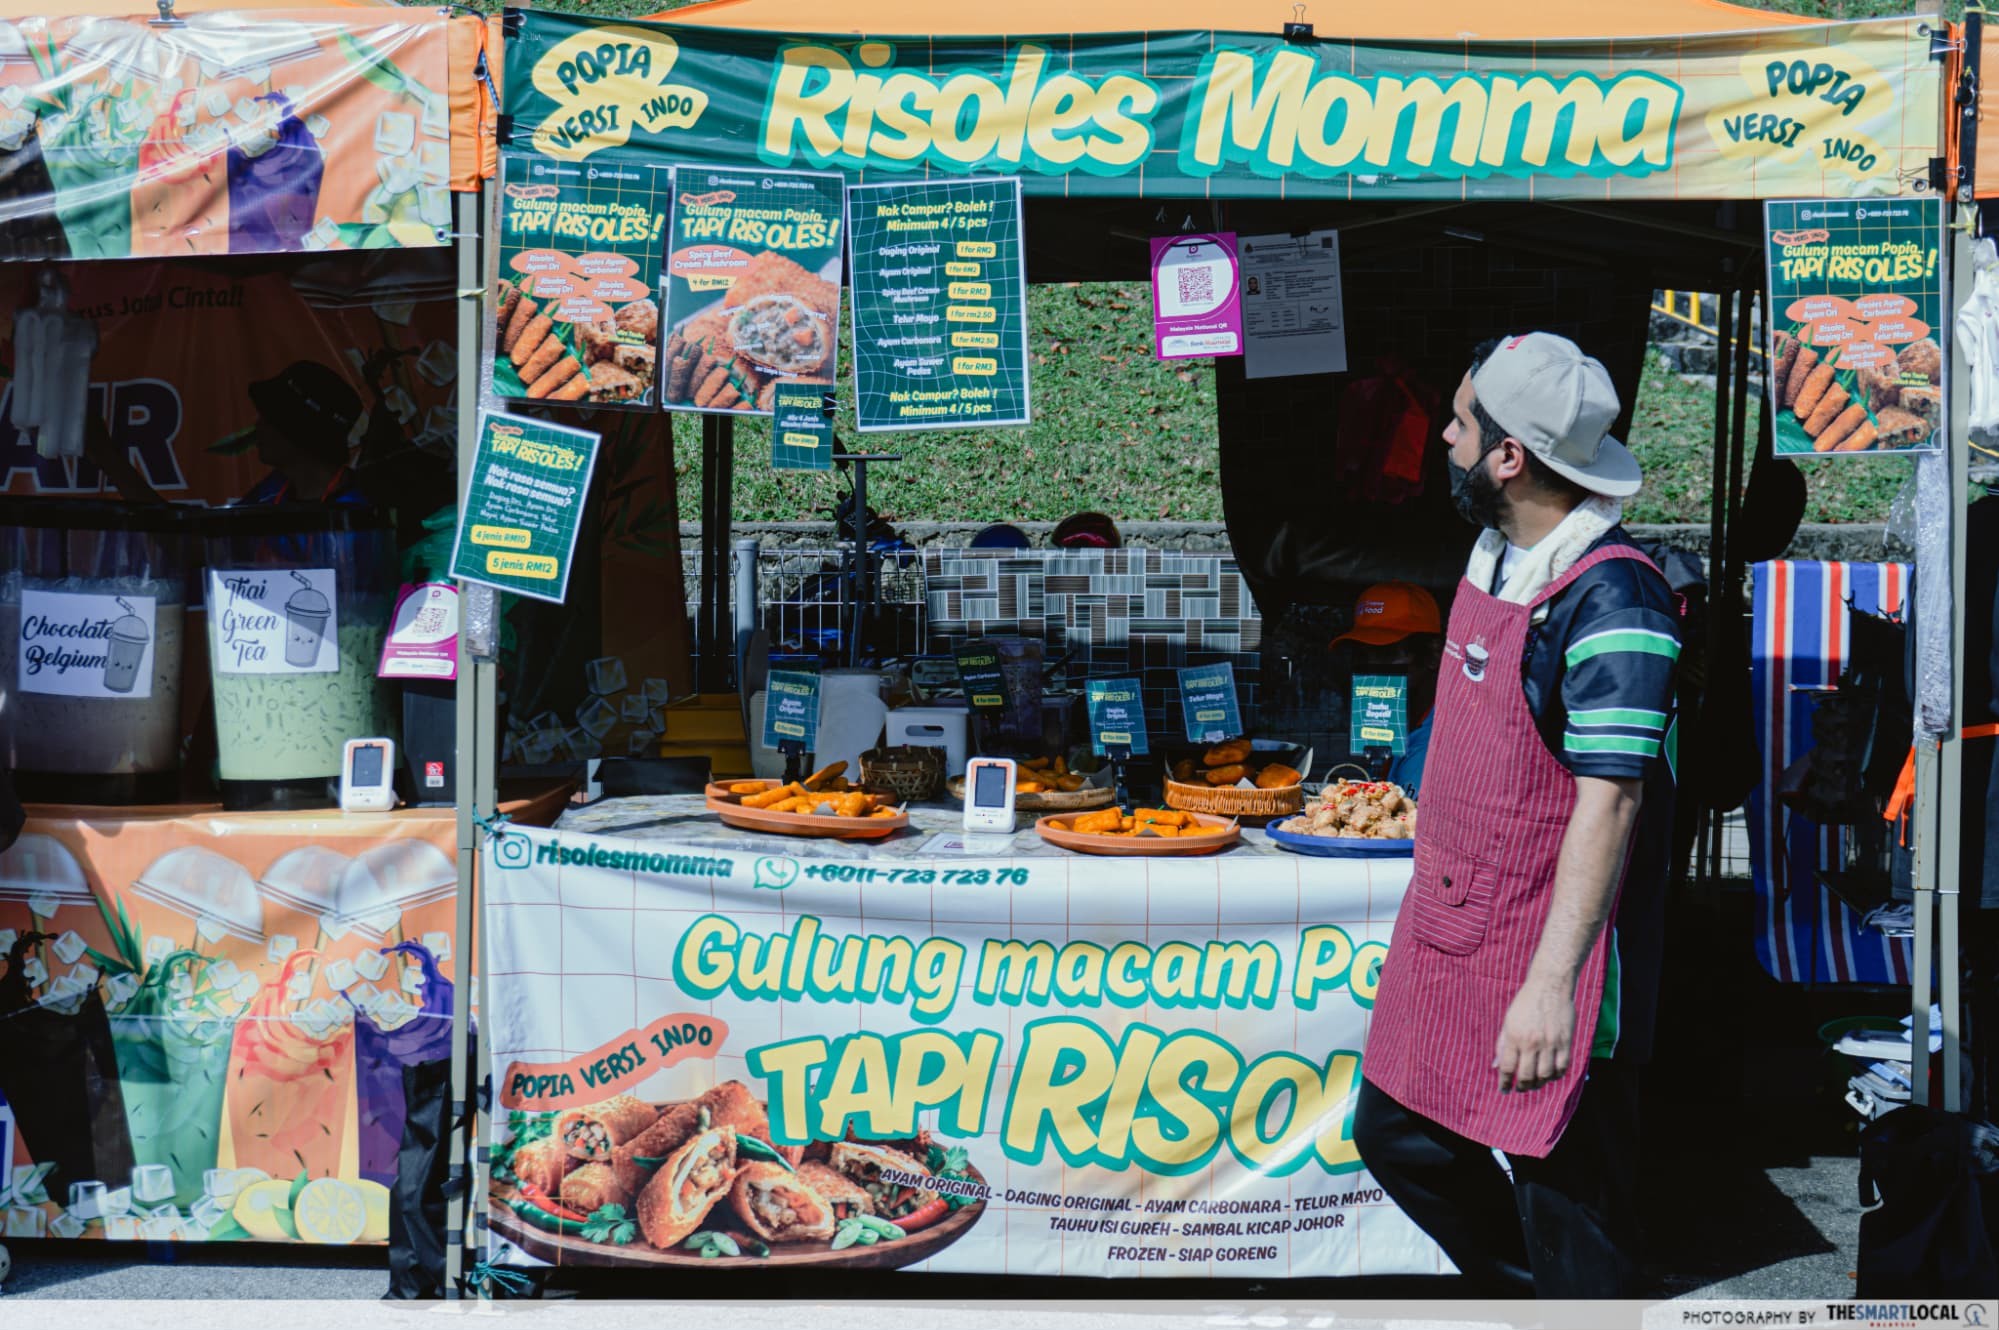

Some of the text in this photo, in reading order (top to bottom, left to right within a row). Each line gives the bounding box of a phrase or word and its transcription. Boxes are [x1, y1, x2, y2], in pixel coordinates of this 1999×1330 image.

[557, 43, 651, 94] POPIA
[1766, 60, 1868, 116] POPIA
[762, 42, 1682, 172] Risoles Momma
[549, 95, 694, 149] VERSI INDO
[1722, 114, 1877, 172] VERSI INDO
[513, 198, 557, 214] Gulung
[559, 202, 606, 214] macam
[686, 203, 731, 220] Gulung
[734, 208, 782, 220] macam
[877, 200, 988, 217] Nak Campur? Boleh
[509, 211, 554, 233] TAPI
[682, 217, 728, 238] TAPI
[886, 216, 988, 232] Minimum 4 5 pcs
[908, 244, 940, 256] Original
[964, 245, 992, 254] for RM2
[1783, 244, 1828, 258] Gulung
[1832, 245, 1878, 256] macam
[1780, 258, 1824, 280] TAPI
[916, 314, 940, 325] Mayo
[890, 387, 990, 402] Nak Campur? Boleh
[900, 403, 992, 416] Minimum 4 5 pcs
[492, 438, 520, 454] TAPI
[484, 474, 572, 508] Nak rasa semua?
[488, 463, 576, 497] Nak rasa semua?
[482, 532, 502, 542] jenis
[504, 534, 527, 544] RM10
[492, 558, 553, 574] 5 jenis RM12
[225, 576, 267, 601] Thai
[22, 614, 114, 641] Chocolate
[222, 611, 281, 643] Green
[26, 643, 109, 676] Belgium
[231, 637, 268, 663] Tea
[535, 842, 1028, 886] risolesmomma +6011-723 723 76
[674, 913, 966, 1022] Gulung
[973, 938, 1282, 1010] macam
[510, 1022, 714, 1099] POPIA VERSI INDO
[748, 1029, 1002, 1147] TAPI
[881, 1168, 1384, 1214] AYAM ORIGINAL DAGING ORIGINAL AYAM CARBONARA TELUR MAYO
[1050, 1214, 1345, 1236] TAUHU ISI GUREH SAMBAL KICAP JOHOR
[1108, 1246, 1278, 1262] FROZEN SIAP GORENG
